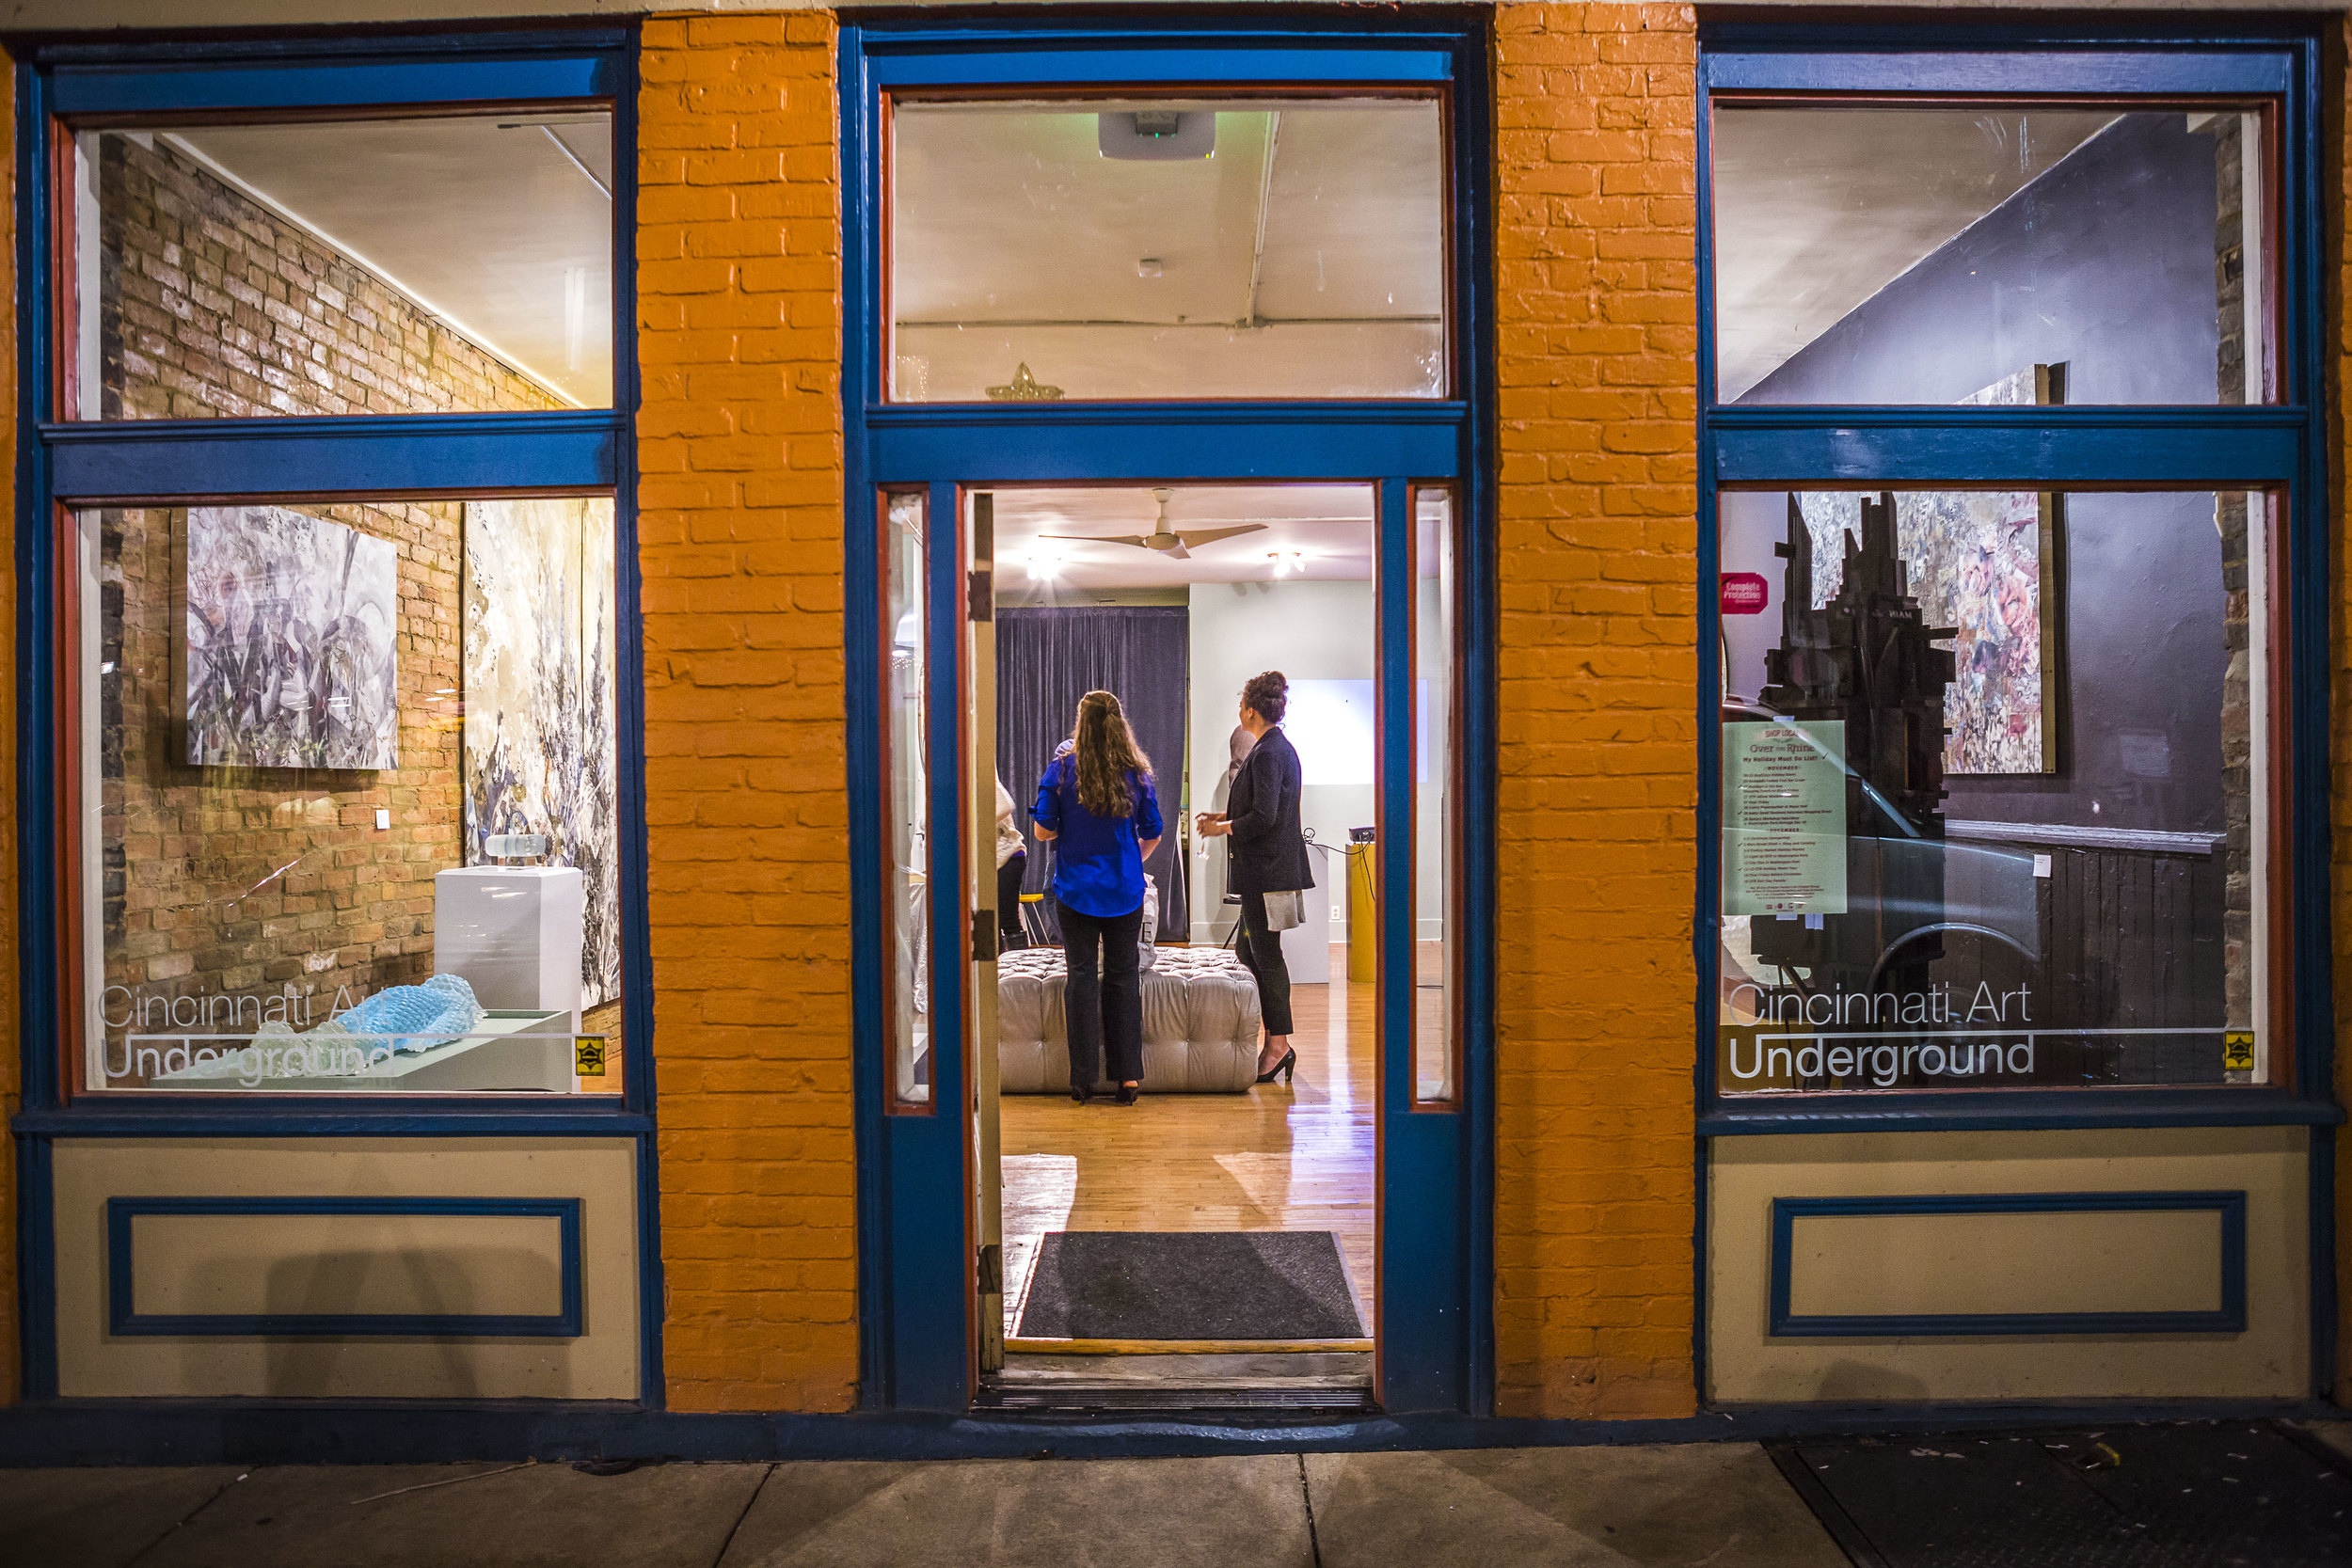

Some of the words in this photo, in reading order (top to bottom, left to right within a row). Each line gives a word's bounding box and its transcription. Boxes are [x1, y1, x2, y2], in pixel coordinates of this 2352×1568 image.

[1724, 591, 1761, 599] Protection
[1725, 582, 1760, 592] Complete
[1750, 744, 1773, 752] Over
[1788, 743, 1815, 753] Rhine
[98, 985, 310, 1027] Cincinnati
[329, 984, 390, 1026] Art
[1729, 981, 1949, 1027] Cincinnati
[1966, 980, 2031, 1022] Art
[102, 1035, 394, 1087] Underground
[1730, 1034, 2034, 1086] Underground
